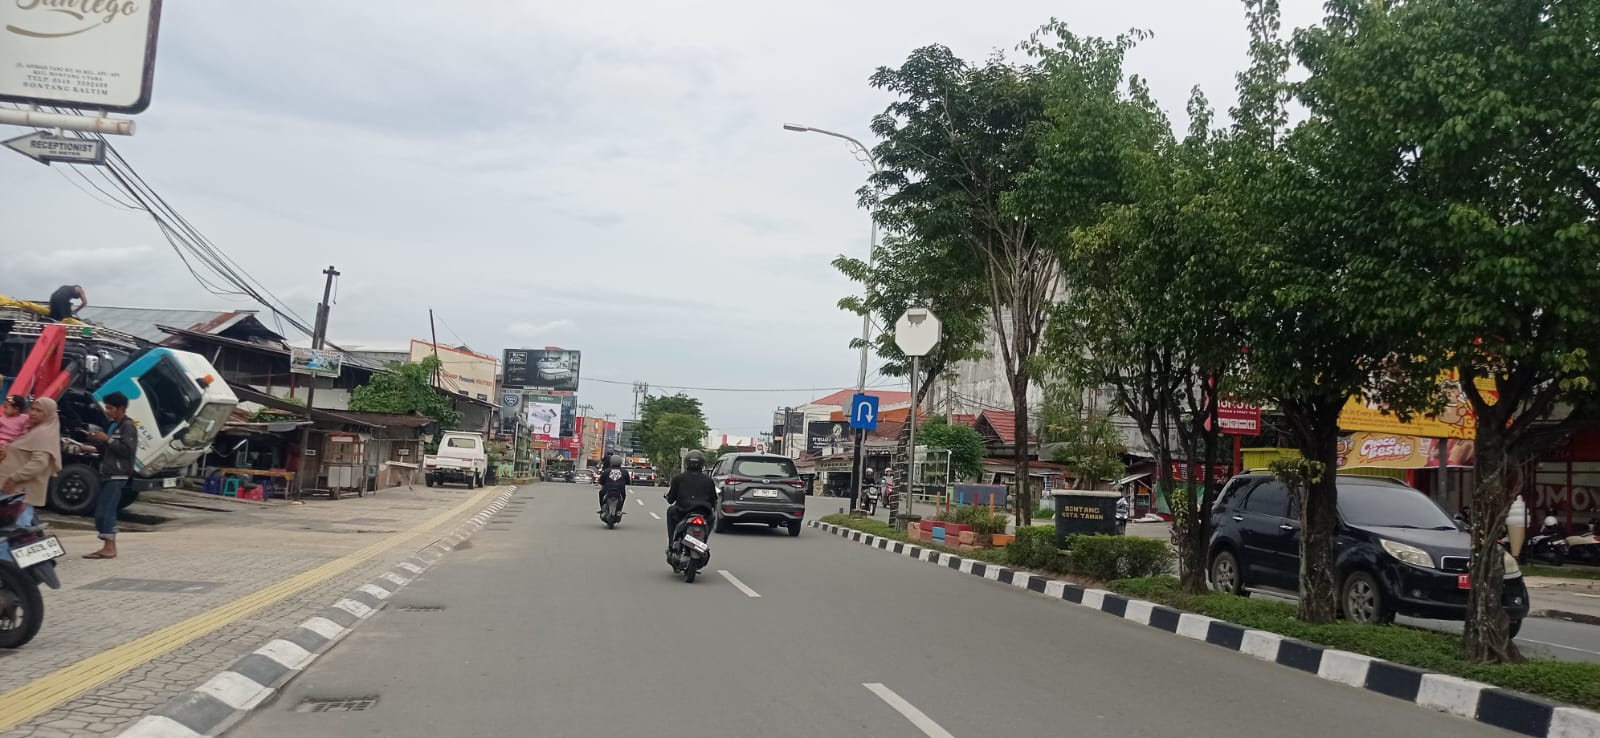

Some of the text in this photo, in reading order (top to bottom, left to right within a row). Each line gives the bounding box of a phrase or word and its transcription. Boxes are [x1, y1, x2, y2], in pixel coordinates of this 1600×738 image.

[23, 81, 108, 95] BONTANG KALTIM
[30, 140, 93, 152] RECEPTIONIST
[1368, 441, 1412, 459] Bestie
[1064, 505, 1100, 514] BONTANG
